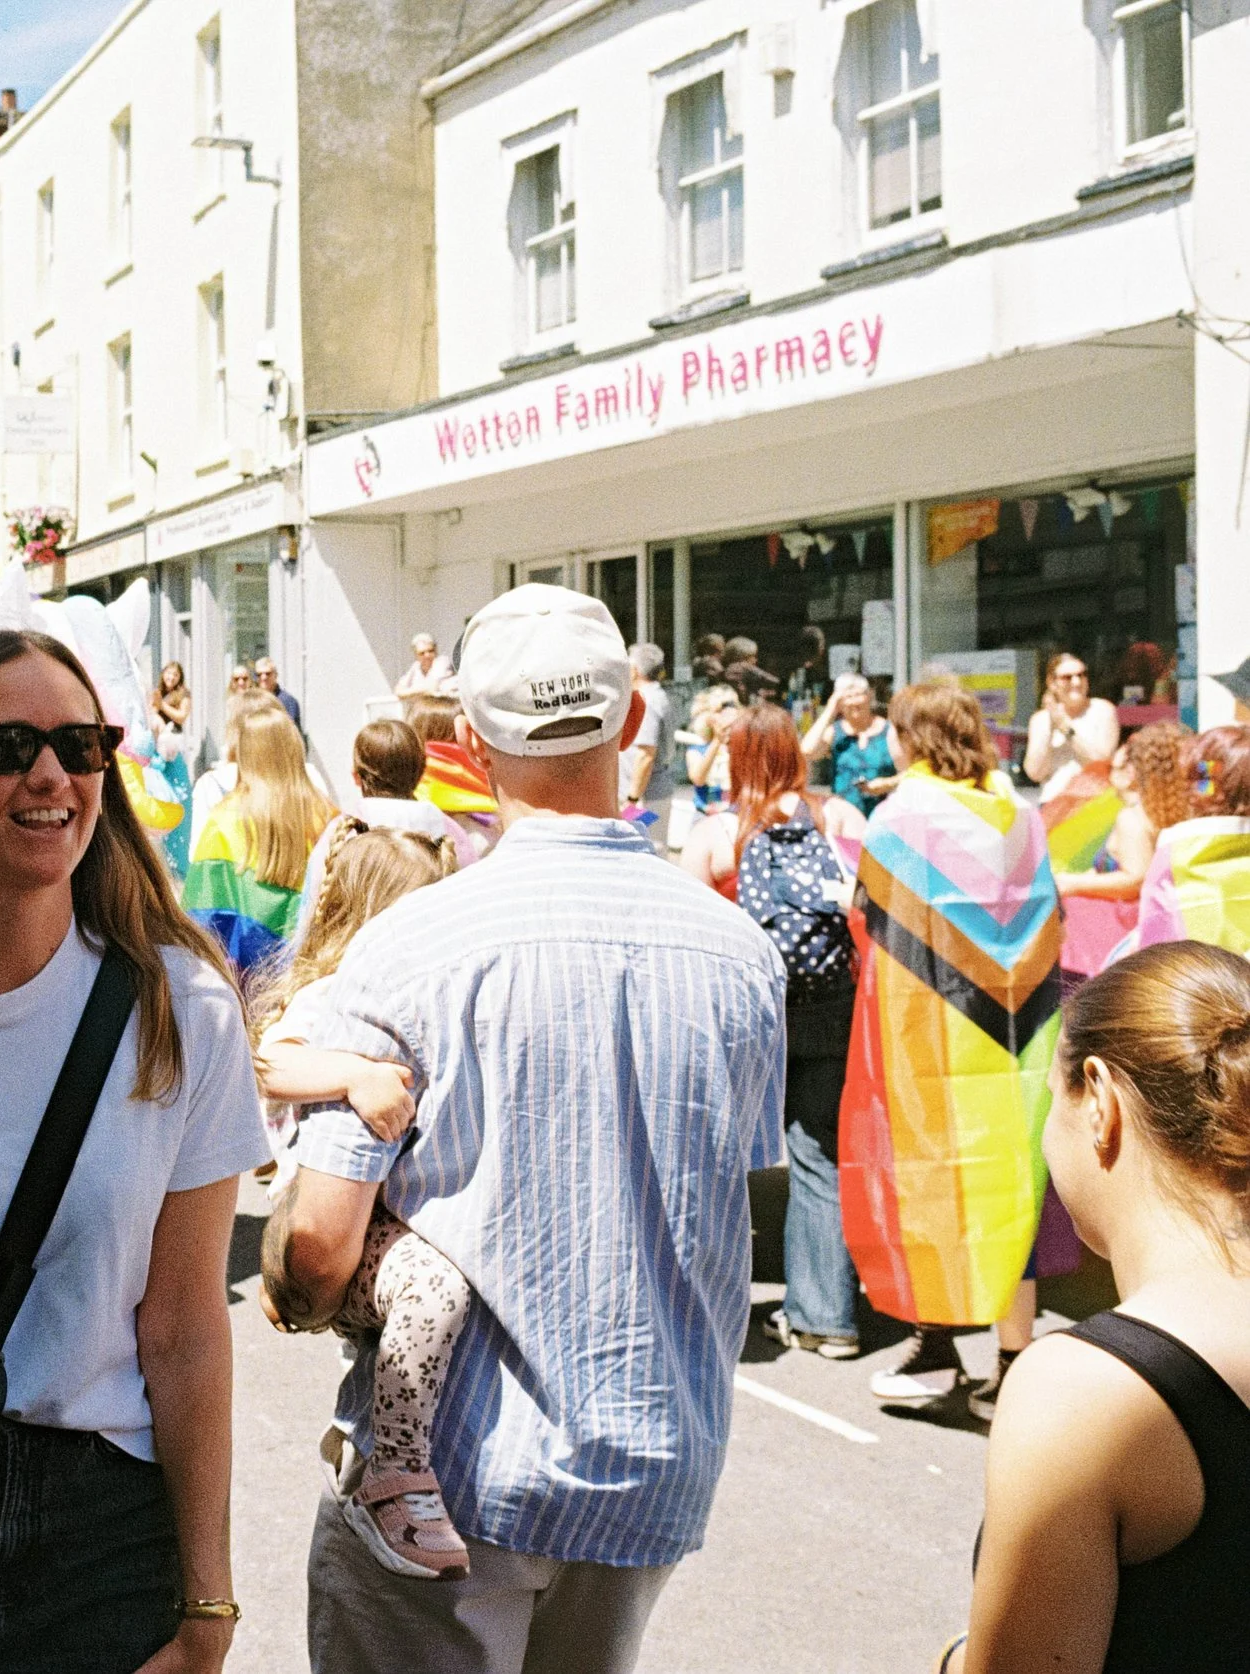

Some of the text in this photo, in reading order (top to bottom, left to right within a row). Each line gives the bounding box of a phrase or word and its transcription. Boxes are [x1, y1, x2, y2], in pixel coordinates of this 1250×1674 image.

[434, 314, 885, 464] Wotton Family Pharmacy
[530, 672, 591, 697] NEW YORK
